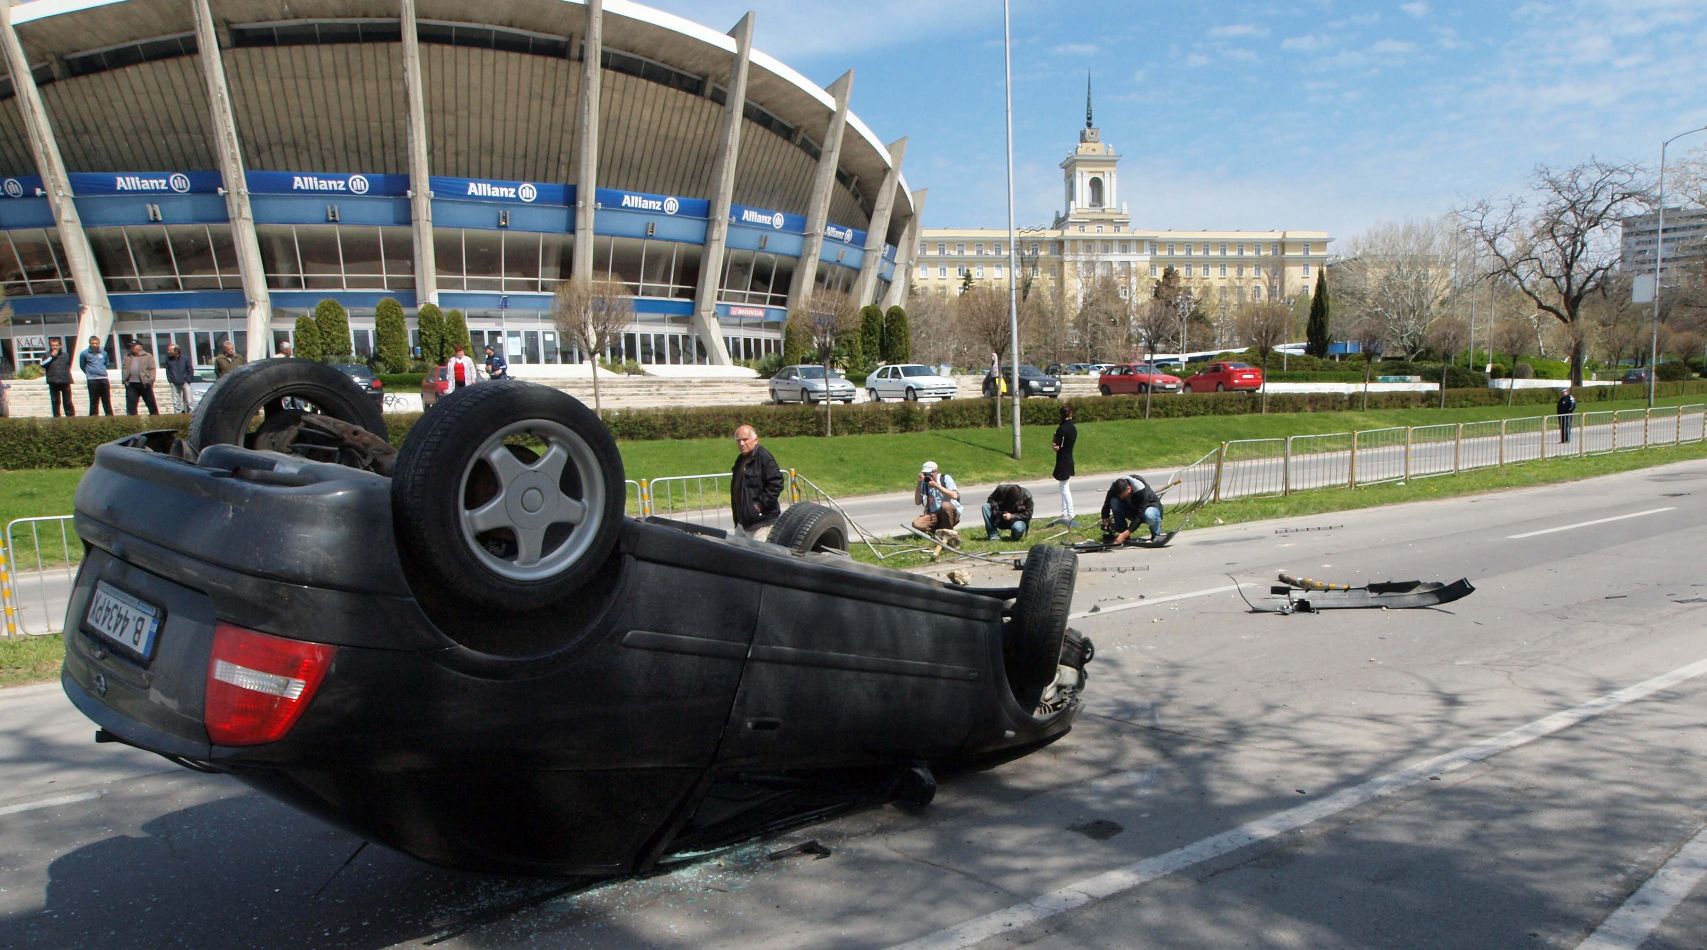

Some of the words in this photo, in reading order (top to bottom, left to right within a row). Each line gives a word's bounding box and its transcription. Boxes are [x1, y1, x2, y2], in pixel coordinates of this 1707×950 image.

[116, 176, 168, 190] Allianz
[293, 176, 346, 191] Allianz
[467, 182, 516, 198] Allianz
[621, 194, 662, 210] Allianz
[742, 209, 772, 225] Allianz
